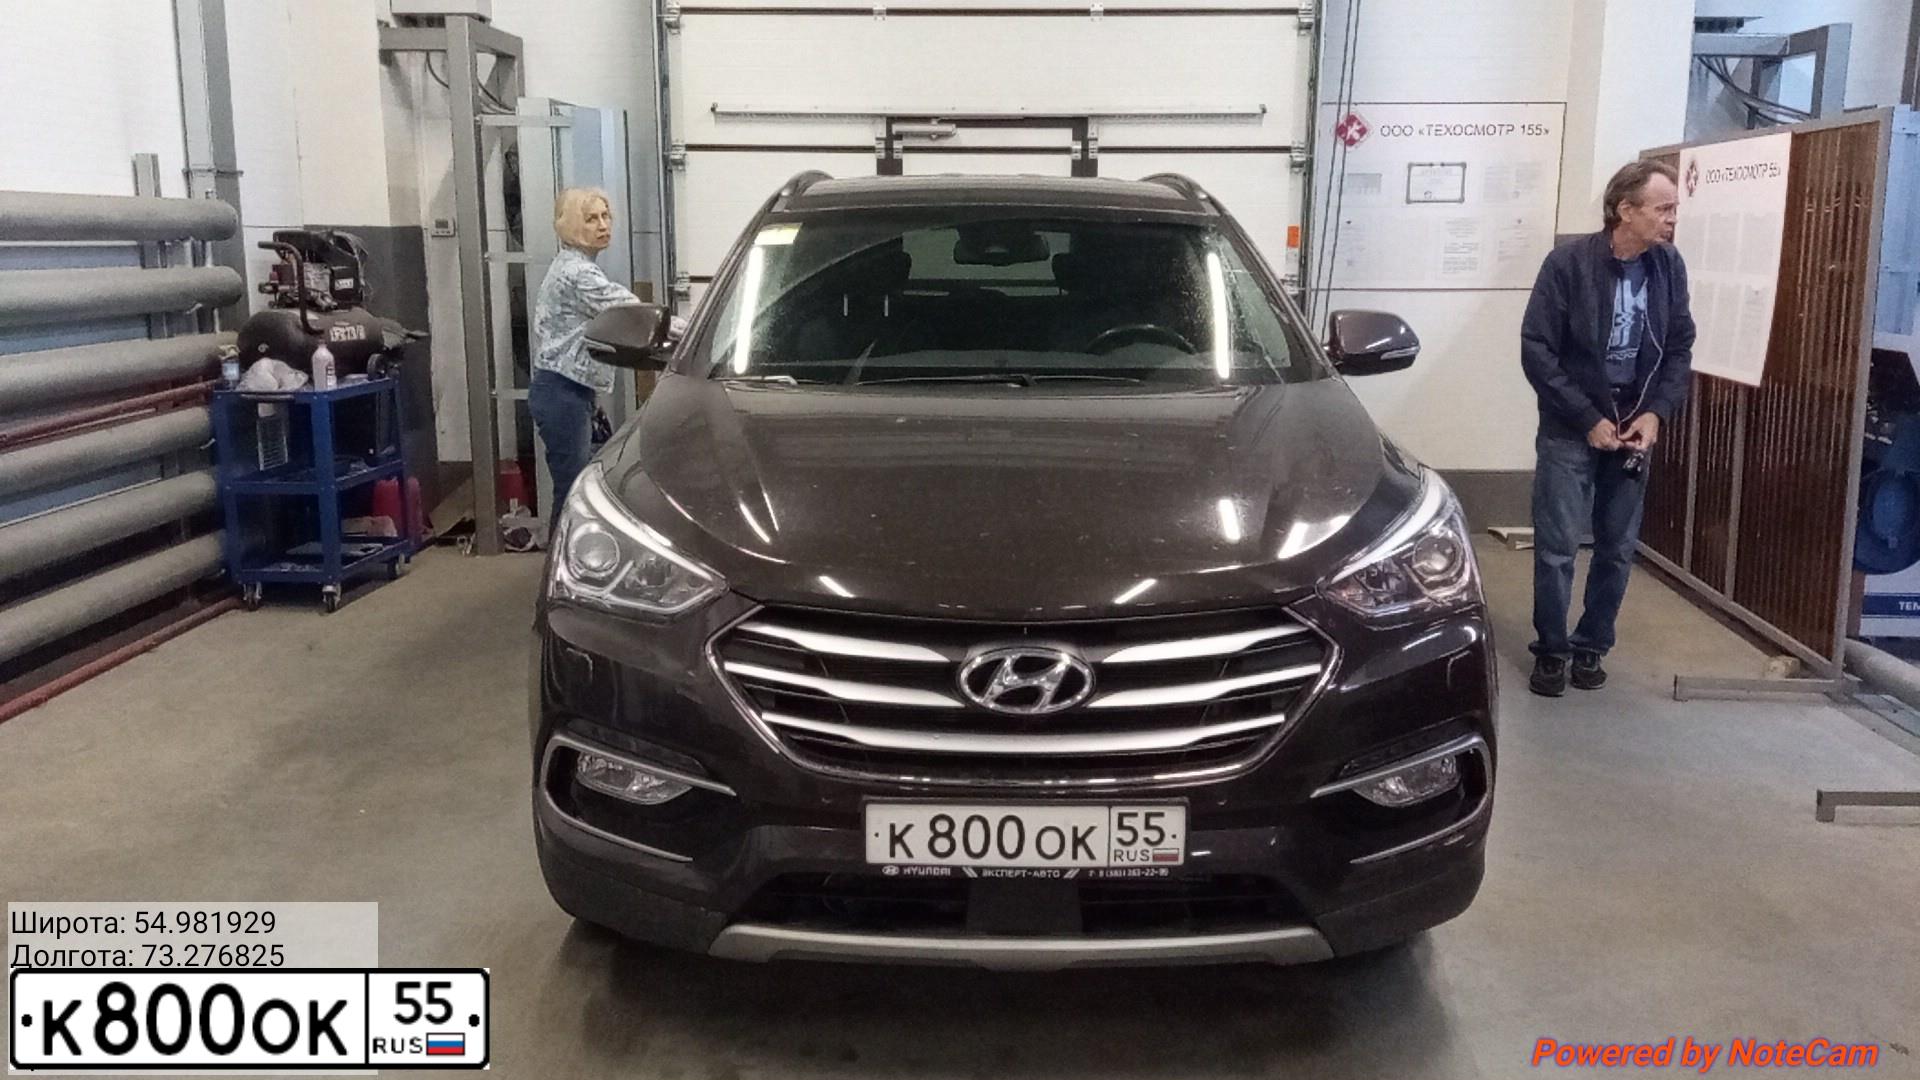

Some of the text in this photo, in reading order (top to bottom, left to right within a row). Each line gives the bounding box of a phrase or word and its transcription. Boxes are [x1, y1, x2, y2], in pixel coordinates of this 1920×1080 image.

[1380, 124, 1414, 137] ООО
[1116, 812, 1165, 847] 55
[1113, 850, 1149, 862] RUS
[903, 866, 950, 876] HYUNDAI
